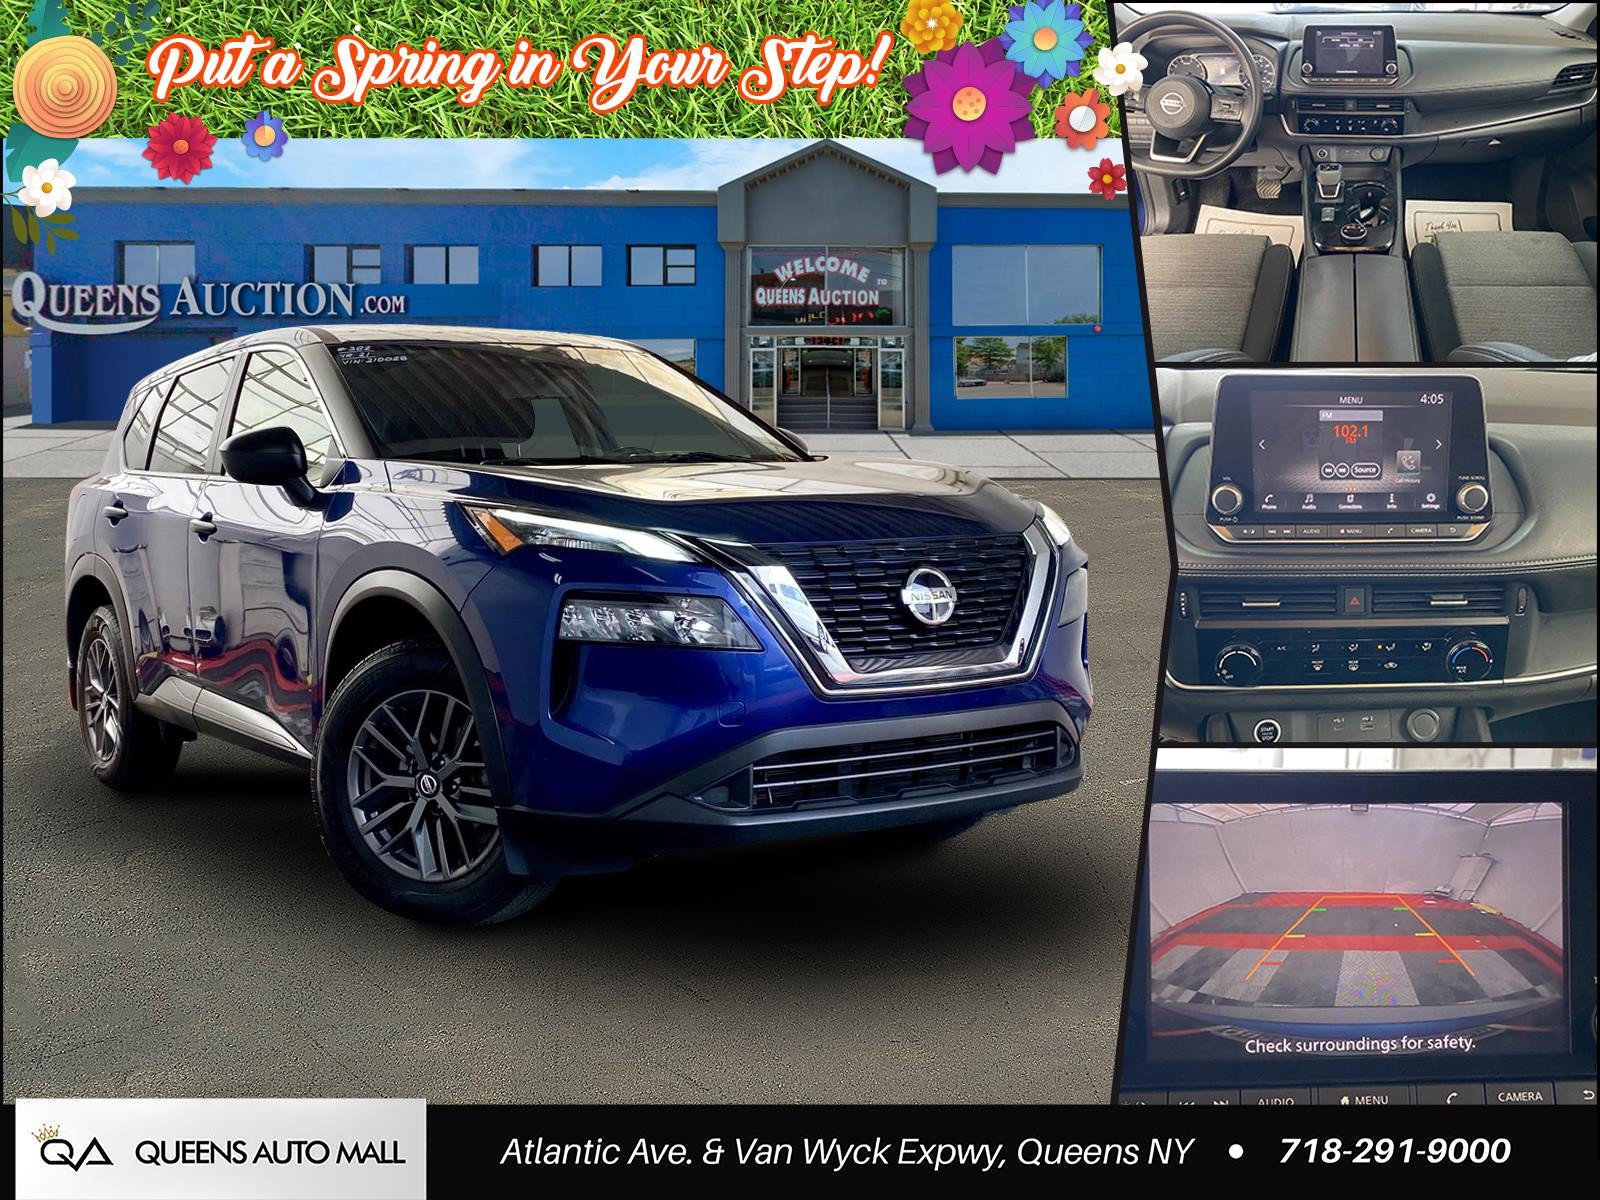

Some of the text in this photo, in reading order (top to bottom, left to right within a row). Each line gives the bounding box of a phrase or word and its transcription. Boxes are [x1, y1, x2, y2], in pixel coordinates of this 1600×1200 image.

[774, 256, 871, 284] WELCOME
[755, 287, 880, 306] QUEENS AUCTION
[11, 271, 161, 335] QUEENS
[169, 276, 356, 317] AUCTION
[1339, 396, 1364, 405] MENU
[1420, 393, 1445, 405] 4:05
[1321, 411, 1333, 419] FM
[1333, 424, 1369, 438] 102.1
[1353, 466, 1377, 474] Source
[910, 590, 953, 602] NISSAN
[1245, 1035, 1476, 1056] Check surroundings for safety.
[1354, 1095, 1389, 1105] MENU
[1498, 1090, 1543, 1102] CAMERA
